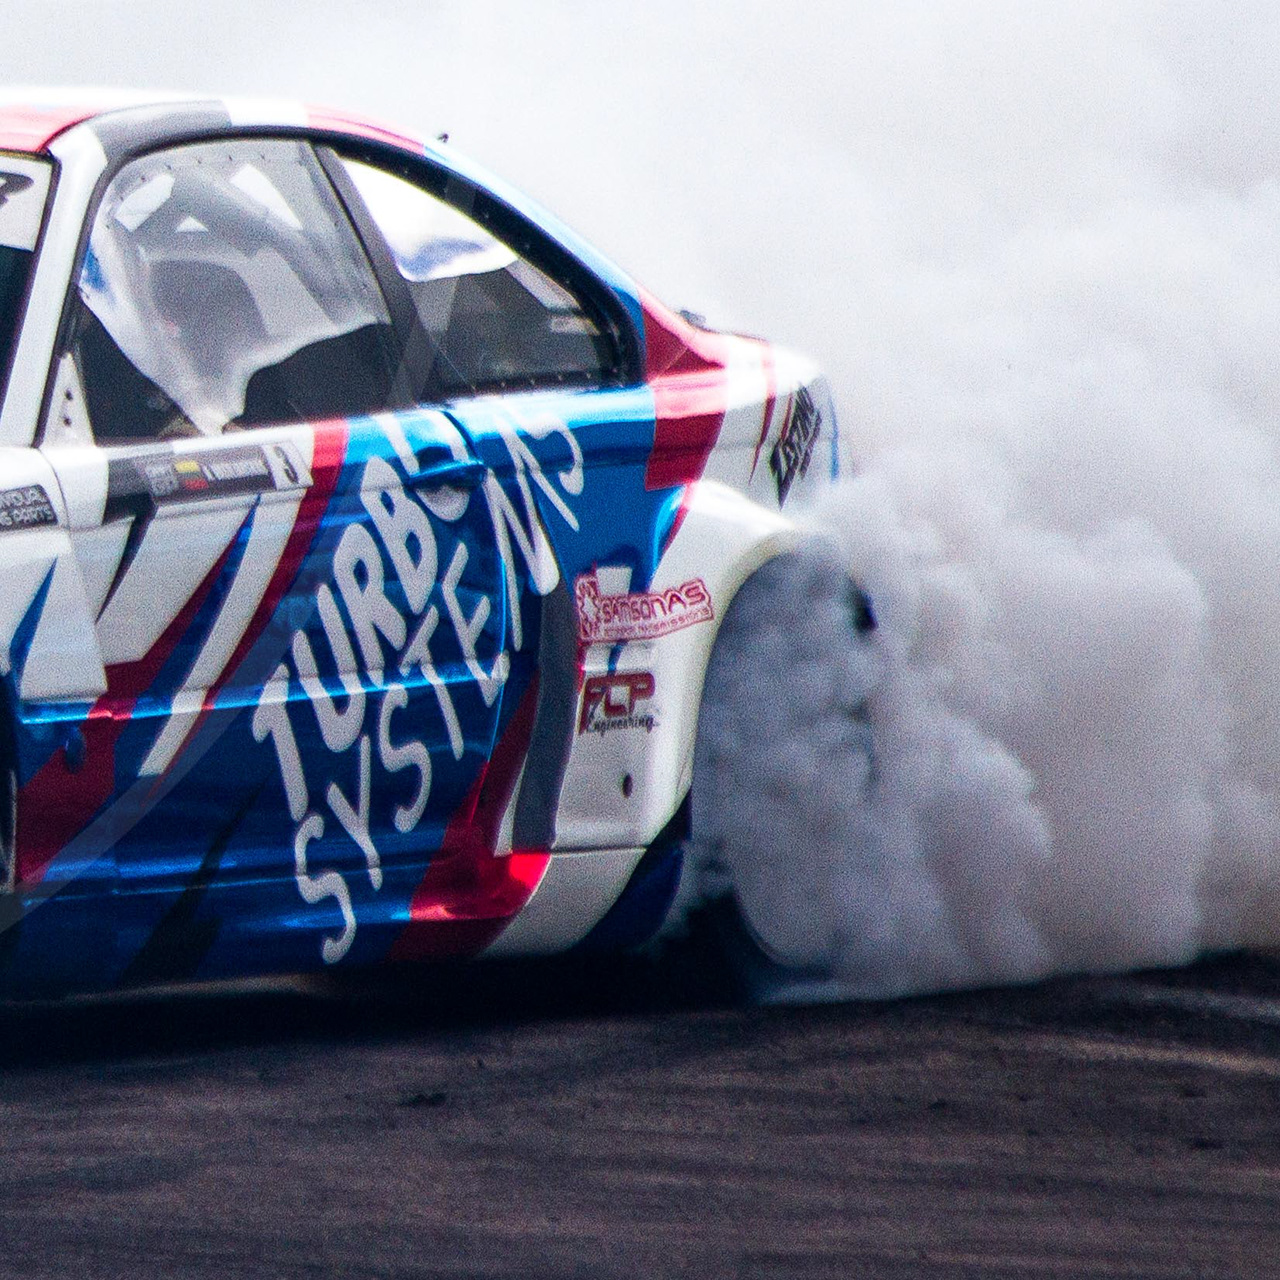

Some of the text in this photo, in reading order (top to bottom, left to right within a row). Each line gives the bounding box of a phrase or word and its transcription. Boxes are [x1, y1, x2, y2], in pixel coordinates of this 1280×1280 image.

[252, 412, 470, 822] TURBO
[272, 444, 301, 485] 3
[295, 412, 584, 966] SYSTEMS
